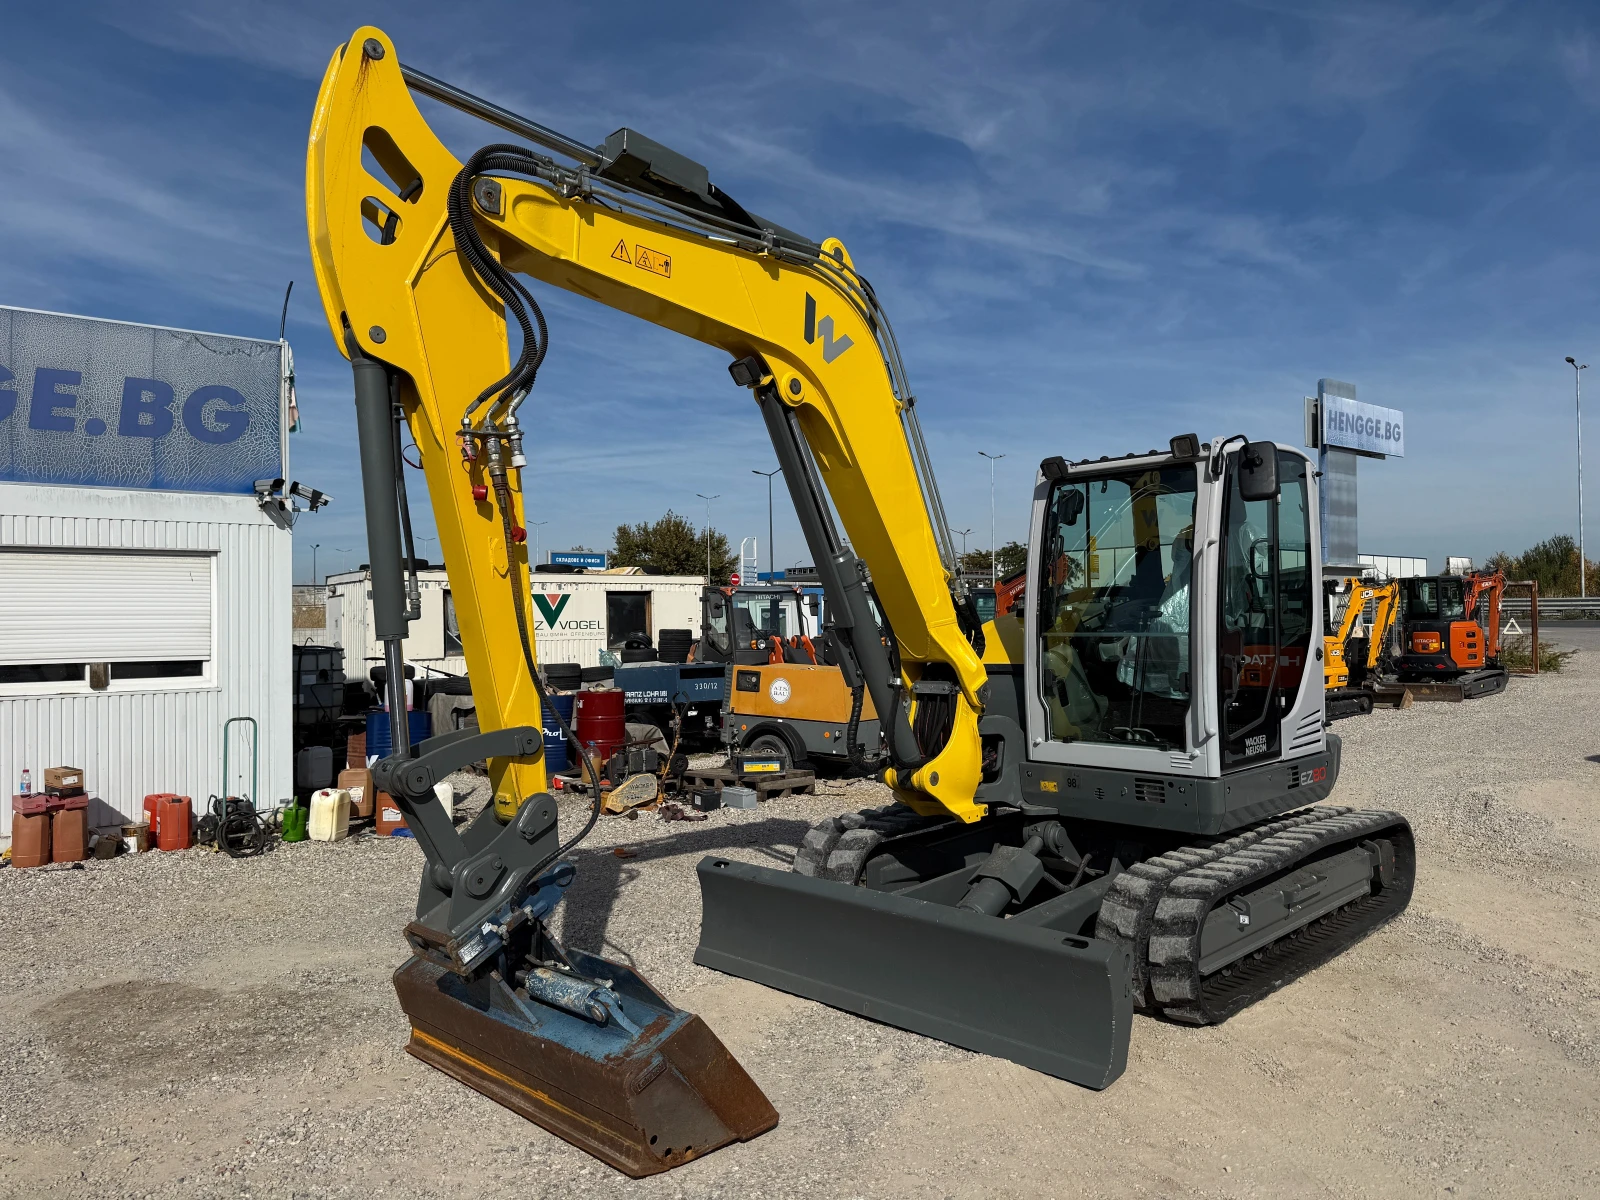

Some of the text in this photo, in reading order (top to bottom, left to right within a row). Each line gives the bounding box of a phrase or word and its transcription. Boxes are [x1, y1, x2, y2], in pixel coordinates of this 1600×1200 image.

[0, 365, 250, 445] E.BG
[1328, 409, 1401, 442] HENGGE.BG
[1360, 588, 1375, 599] JCB
[559, 620, 605, 630] VOGEL
[694, 682, 718, 691] 330/12
[1244, 735, 1267, 748] WACKER
[1245, 743, 1267, 757] NEUSON
[1300, 766, 1327, 786] EZ80
[1066, 778, 1077, 788] 98
